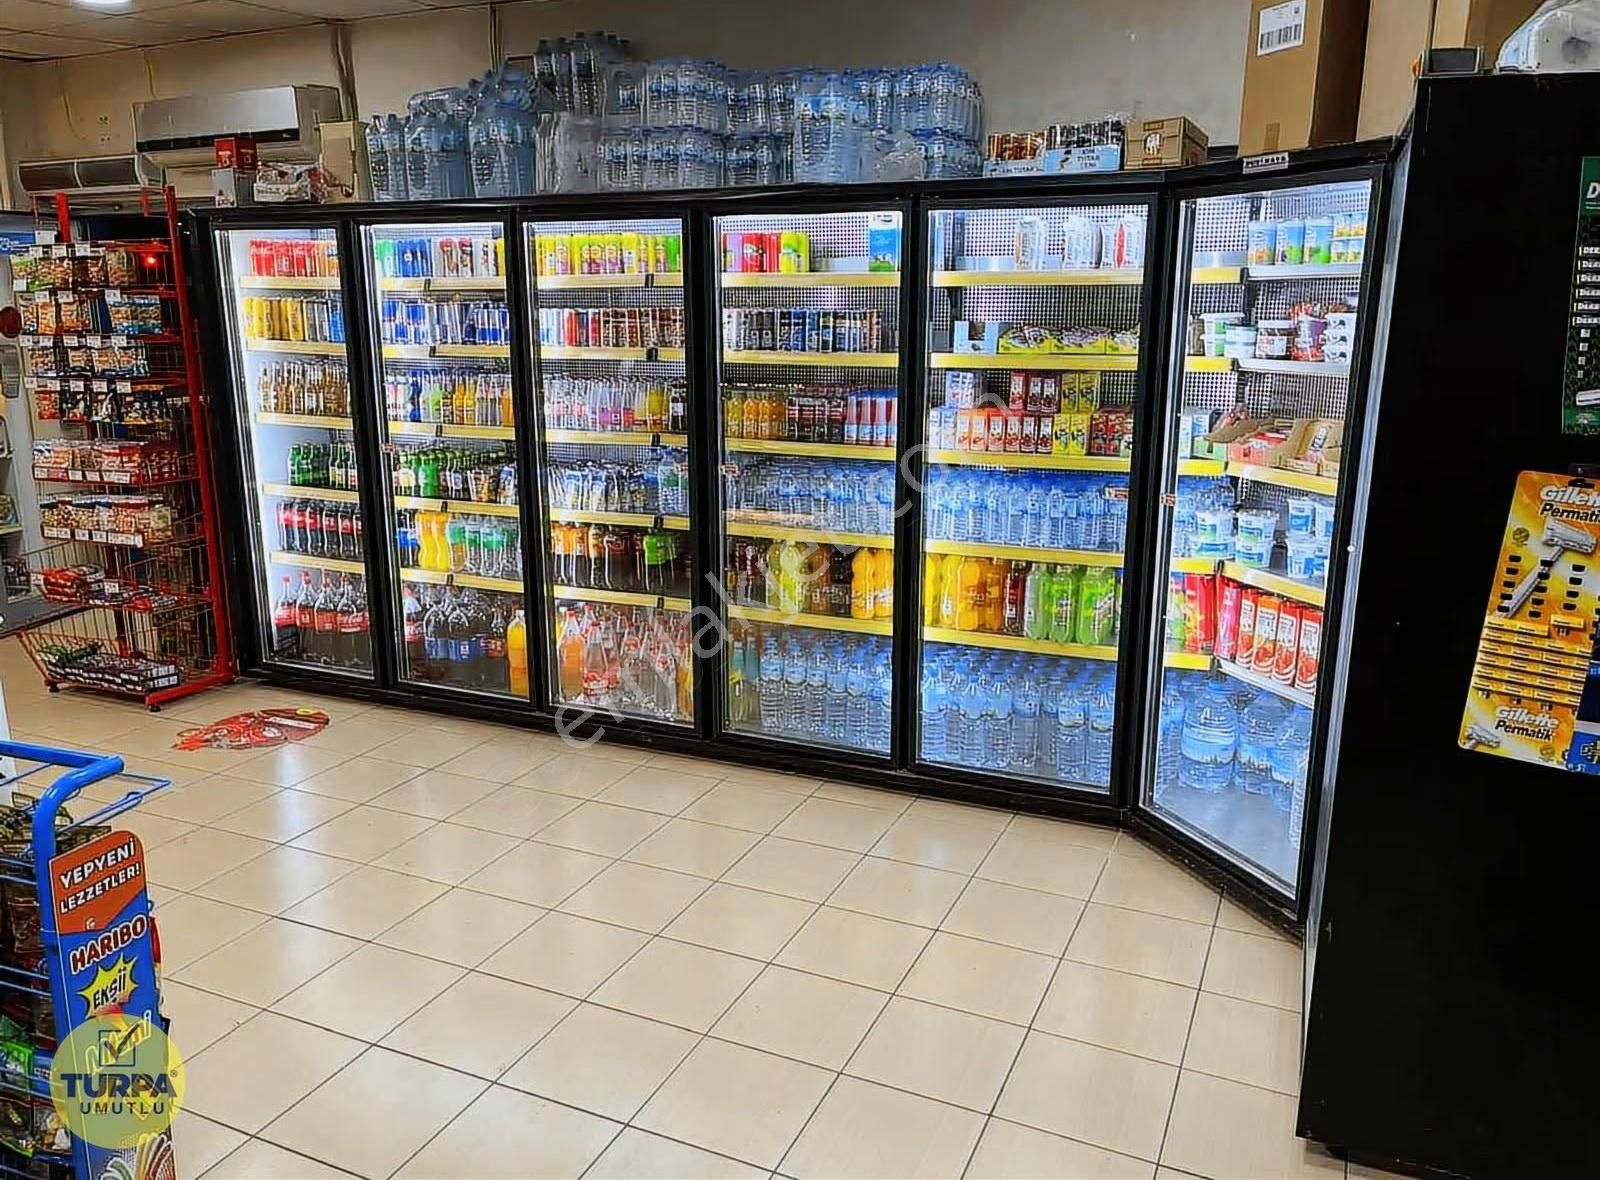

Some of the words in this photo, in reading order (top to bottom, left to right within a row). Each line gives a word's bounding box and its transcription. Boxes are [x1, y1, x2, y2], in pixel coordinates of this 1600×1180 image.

[1539, 501, 1600, 523] Permati
[1494, 719, 1554, 742] Permatik
[60, 837, 136, 889] YEPYENİ
[60, 863, 140, 914] LEZZETLER!
[69, 914, 148, 976] HARIBO
